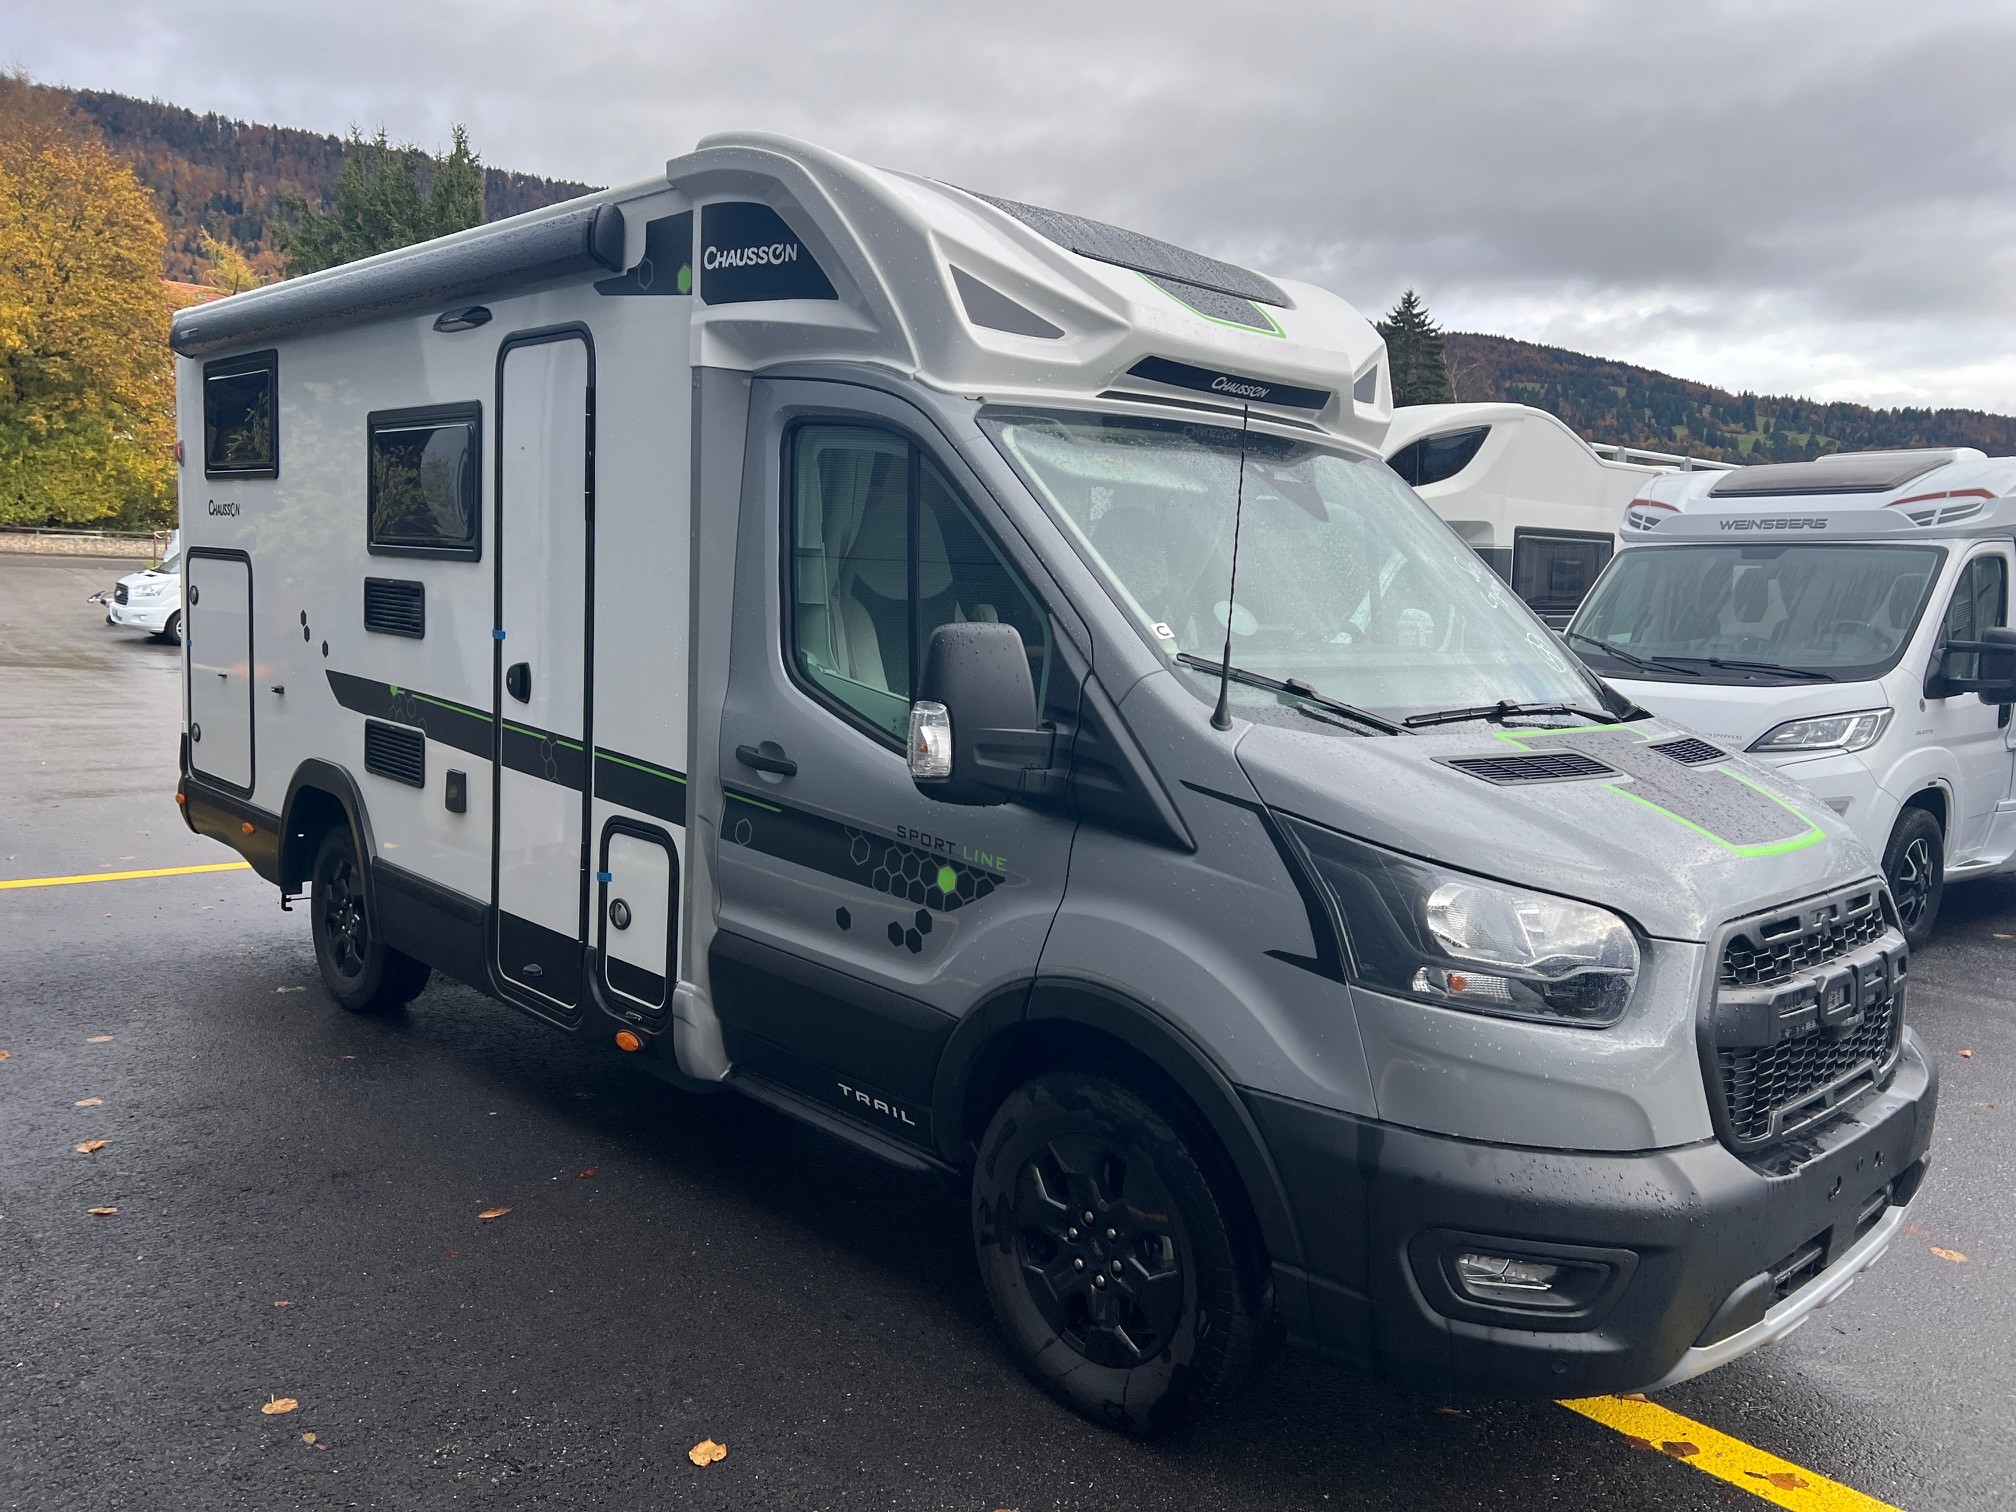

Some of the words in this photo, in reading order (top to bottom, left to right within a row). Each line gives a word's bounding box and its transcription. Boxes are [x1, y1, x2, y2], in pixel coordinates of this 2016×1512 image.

[703, 243, 798, 270] CHAUSSON
[1211, 376, 1270, 397] CHAUSSON
[208, 499, 240, 517] CHAUSSON
[1719, 518, 1828, 531] WEINSBERG
[896, 825, 956, 855] SPORT
[963, 846, 1007, 872] LINE
[837, 1082, 916, 1126] TRAIL
